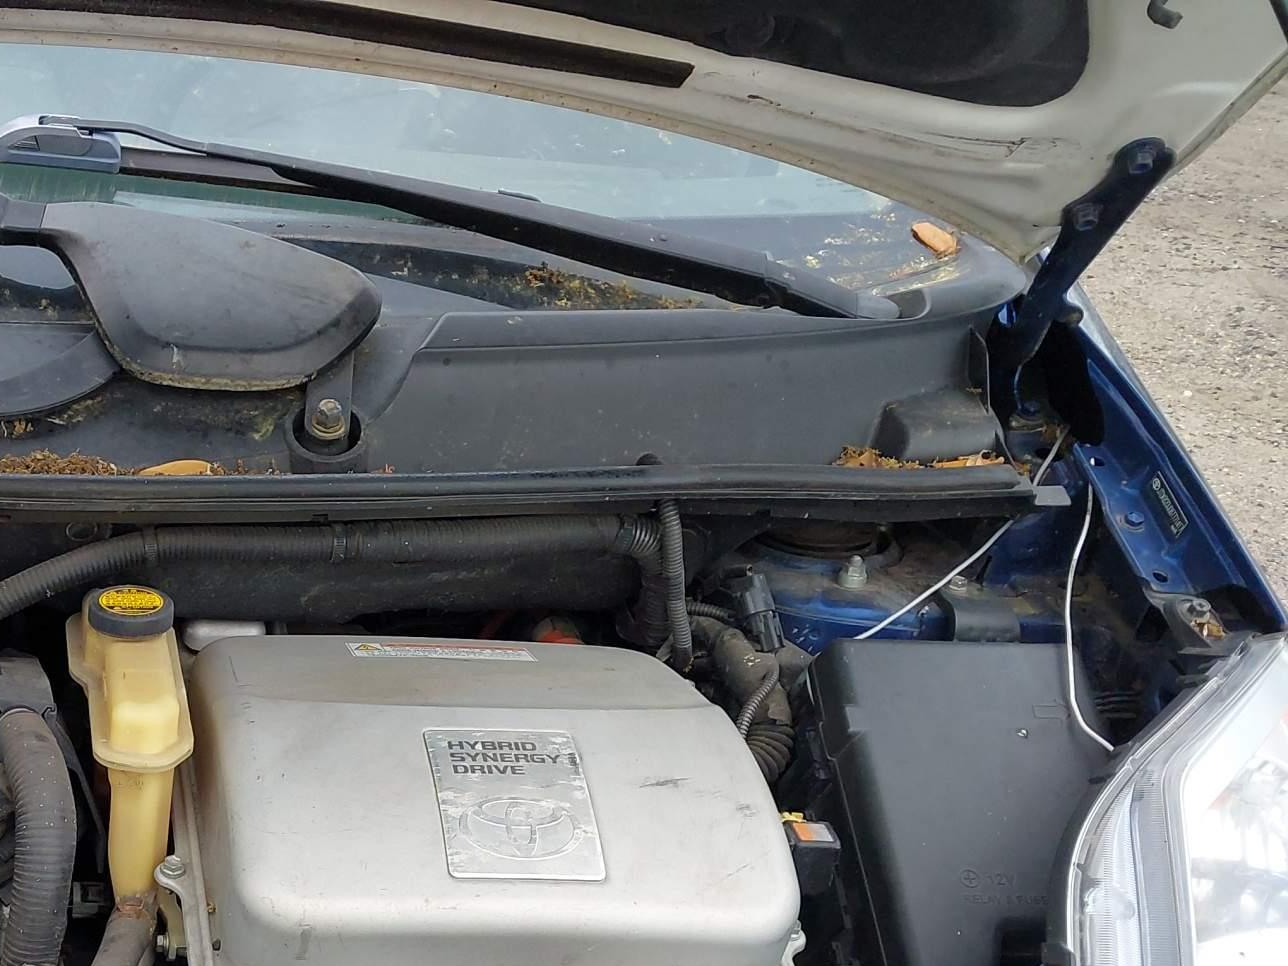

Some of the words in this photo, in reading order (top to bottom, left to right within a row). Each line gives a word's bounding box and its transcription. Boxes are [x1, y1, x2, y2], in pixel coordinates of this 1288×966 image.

[447, 740, 537, 751] HYBRID
[449, 752, 561, 764] SYNERGY
[452, 764, 526, 775] DRIVE
